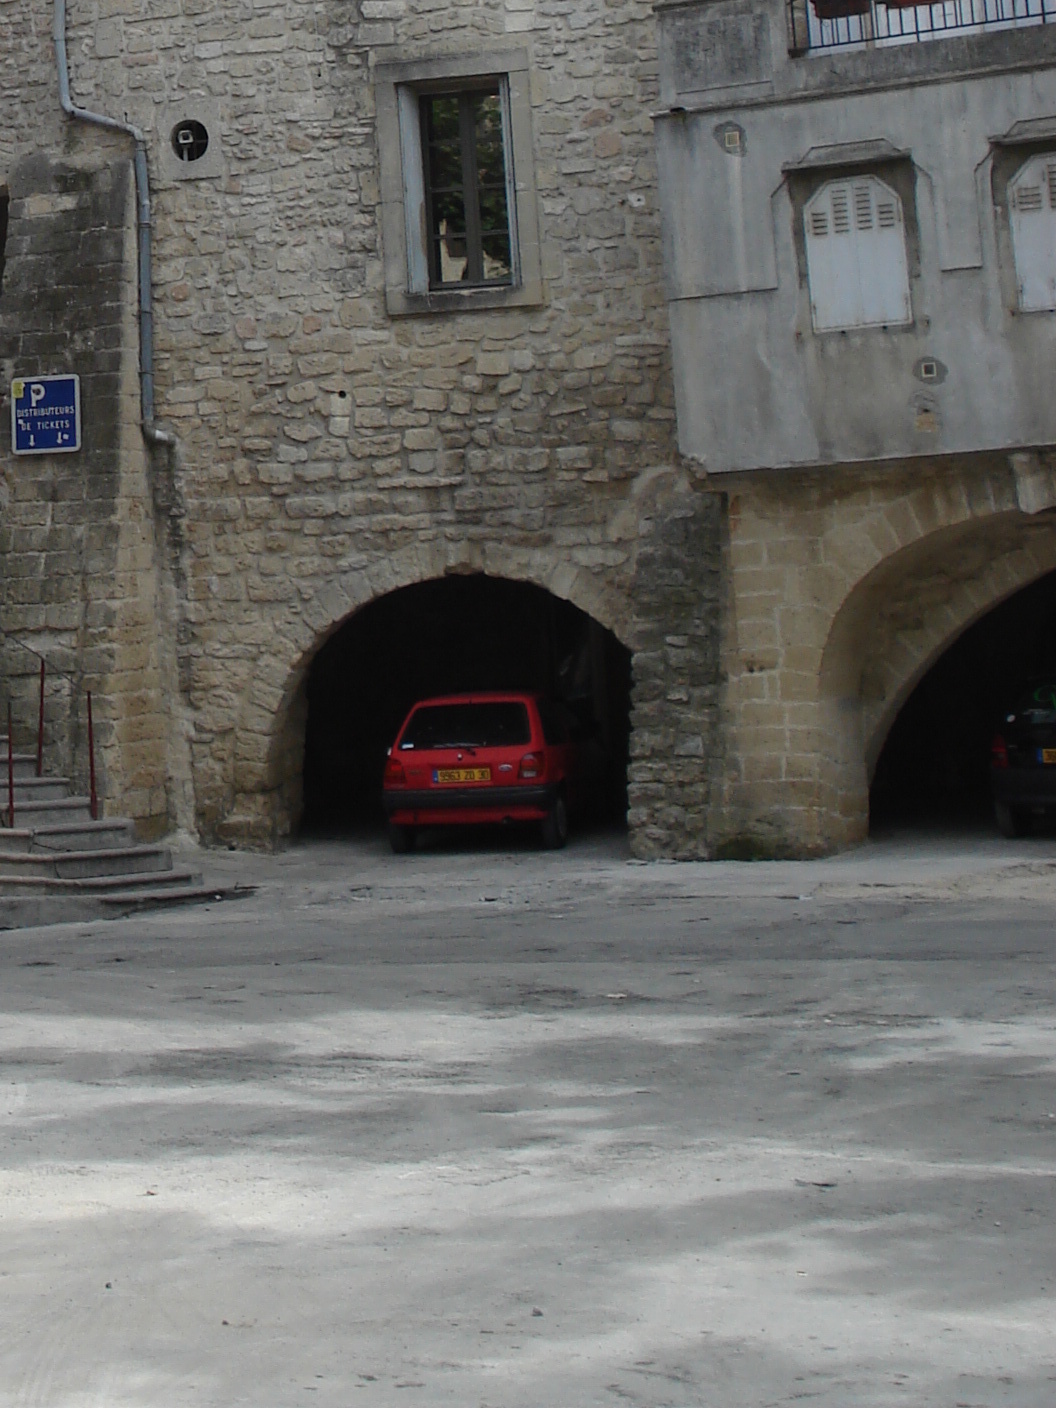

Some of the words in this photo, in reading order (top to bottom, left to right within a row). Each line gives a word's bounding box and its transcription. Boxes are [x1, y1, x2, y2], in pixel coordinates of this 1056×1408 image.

[31, 383, 45, 407] P
[17, 405, 74, 418] DISTRIBUTEURS
[21, 421, 32, 431] DE
[37, 419, 70, 430] TICKETS
